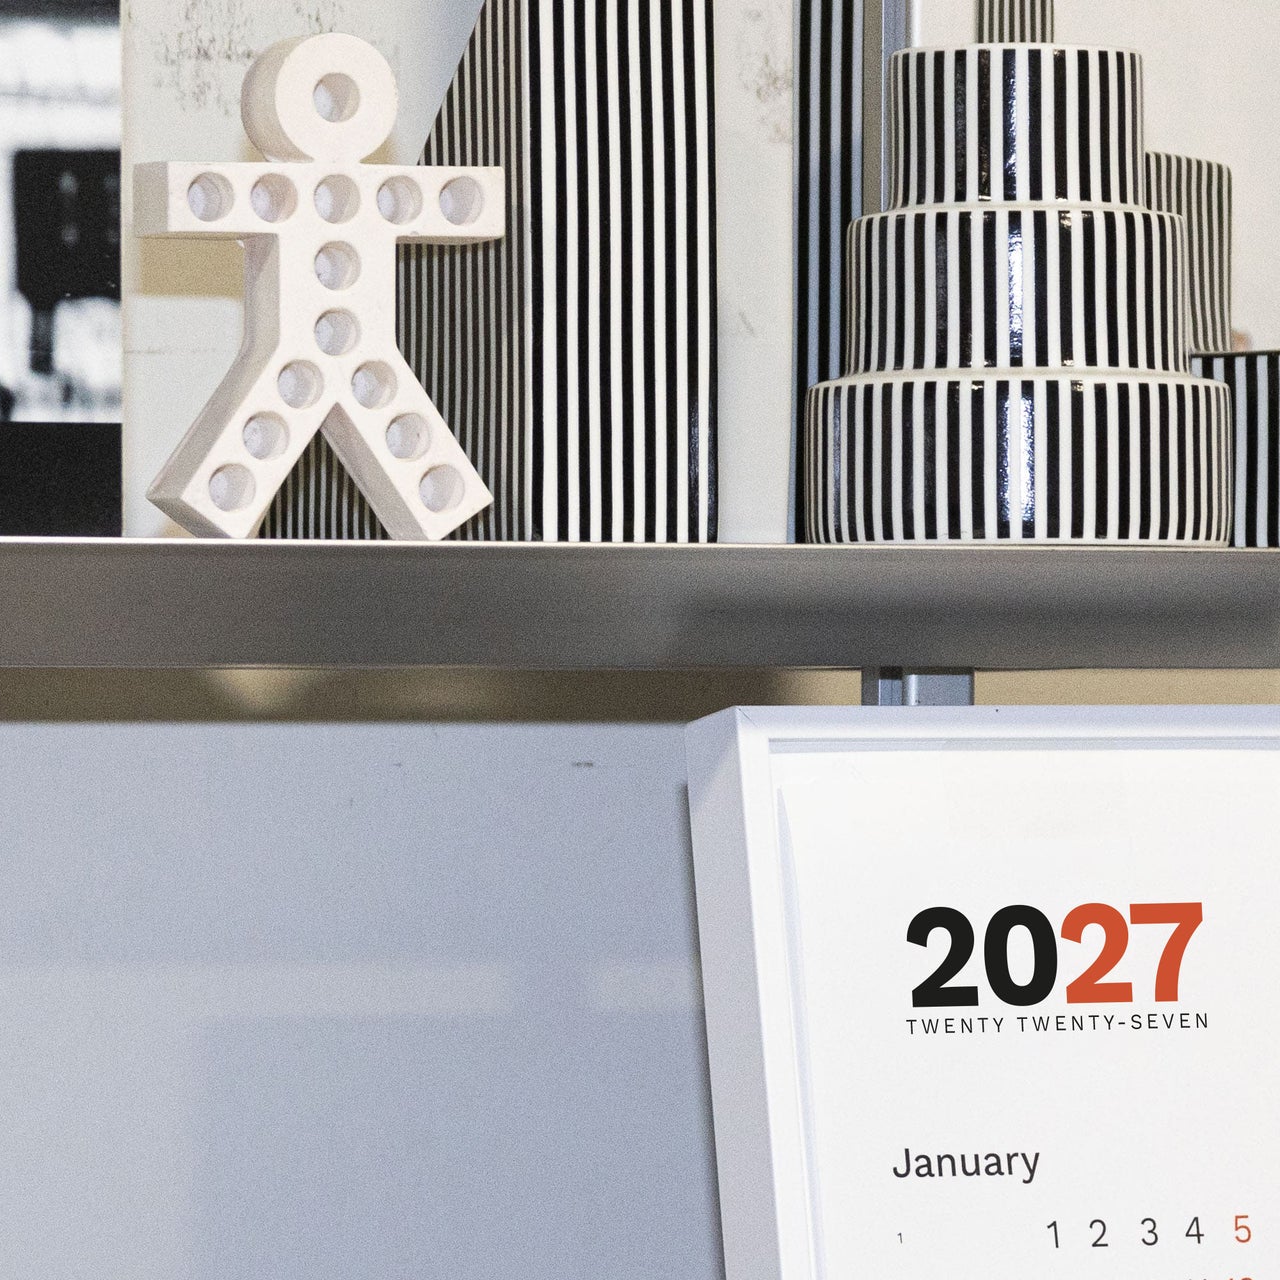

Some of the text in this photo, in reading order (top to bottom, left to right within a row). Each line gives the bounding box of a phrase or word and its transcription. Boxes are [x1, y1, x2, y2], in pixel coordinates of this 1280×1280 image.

[907, 903, 1202, 1007] 2027
[906, 1013, 1207, 1034] TWENTY TWENTY-SEVEN
[893, 1148, 1039, 1184] January
[1047, 1215, 1251, 1248] 1 2 3 4 5
